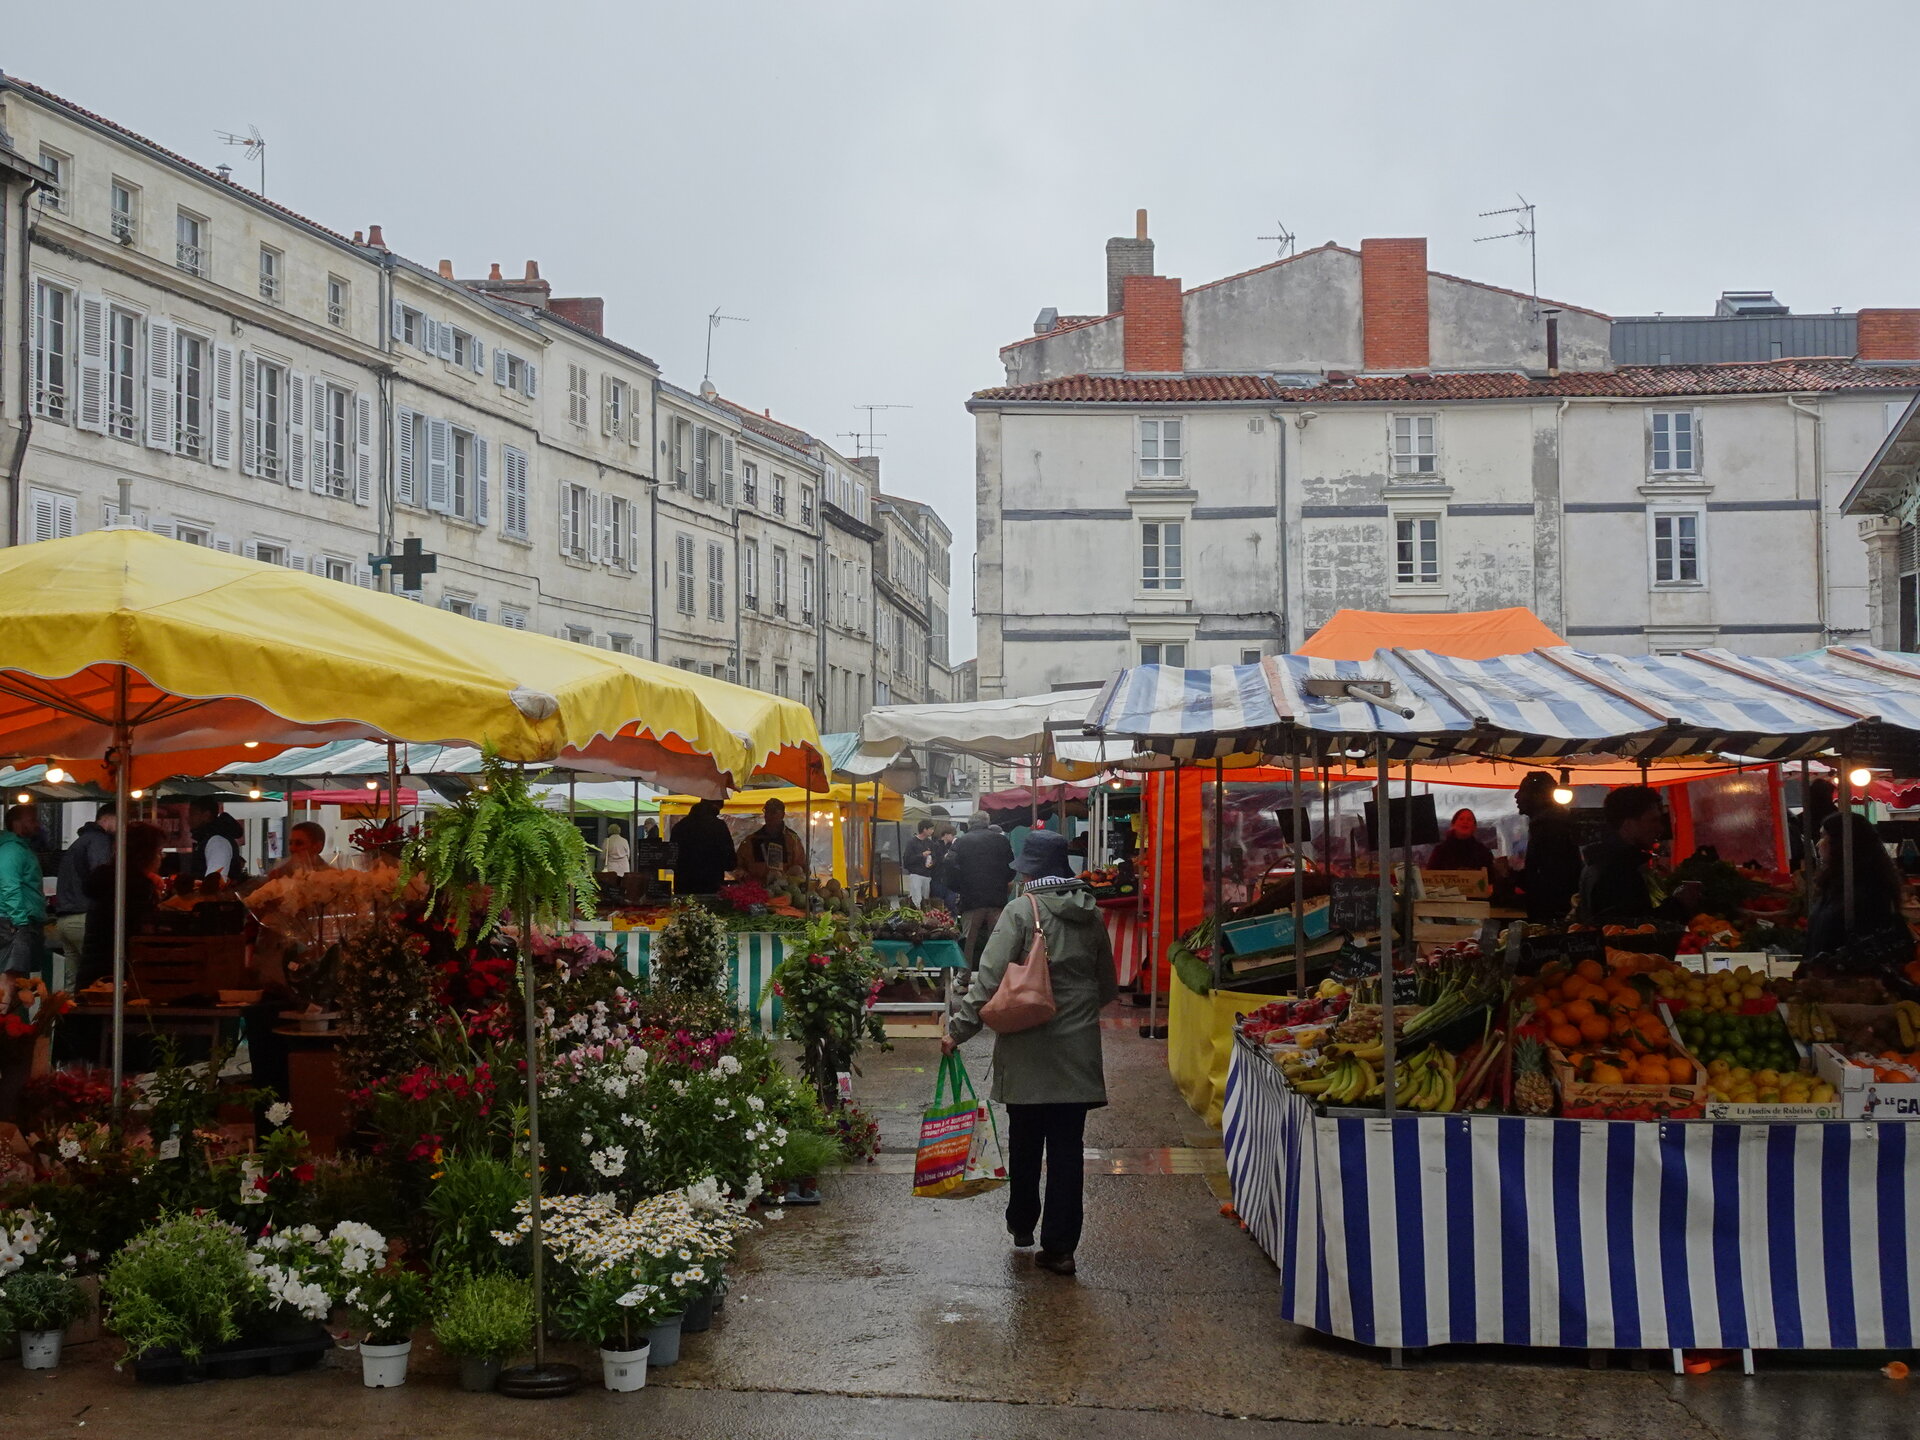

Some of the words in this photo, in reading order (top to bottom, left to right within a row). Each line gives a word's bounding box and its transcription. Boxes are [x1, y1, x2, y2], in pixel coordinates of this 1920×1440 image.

[1575, 1085, 1594, 1096] La
[1885, 1097, 1896, 1105] LE
[1747, 1107, 1771, 1115] Jardin
[1783, 1106, 1813, 1114] Rabelais
